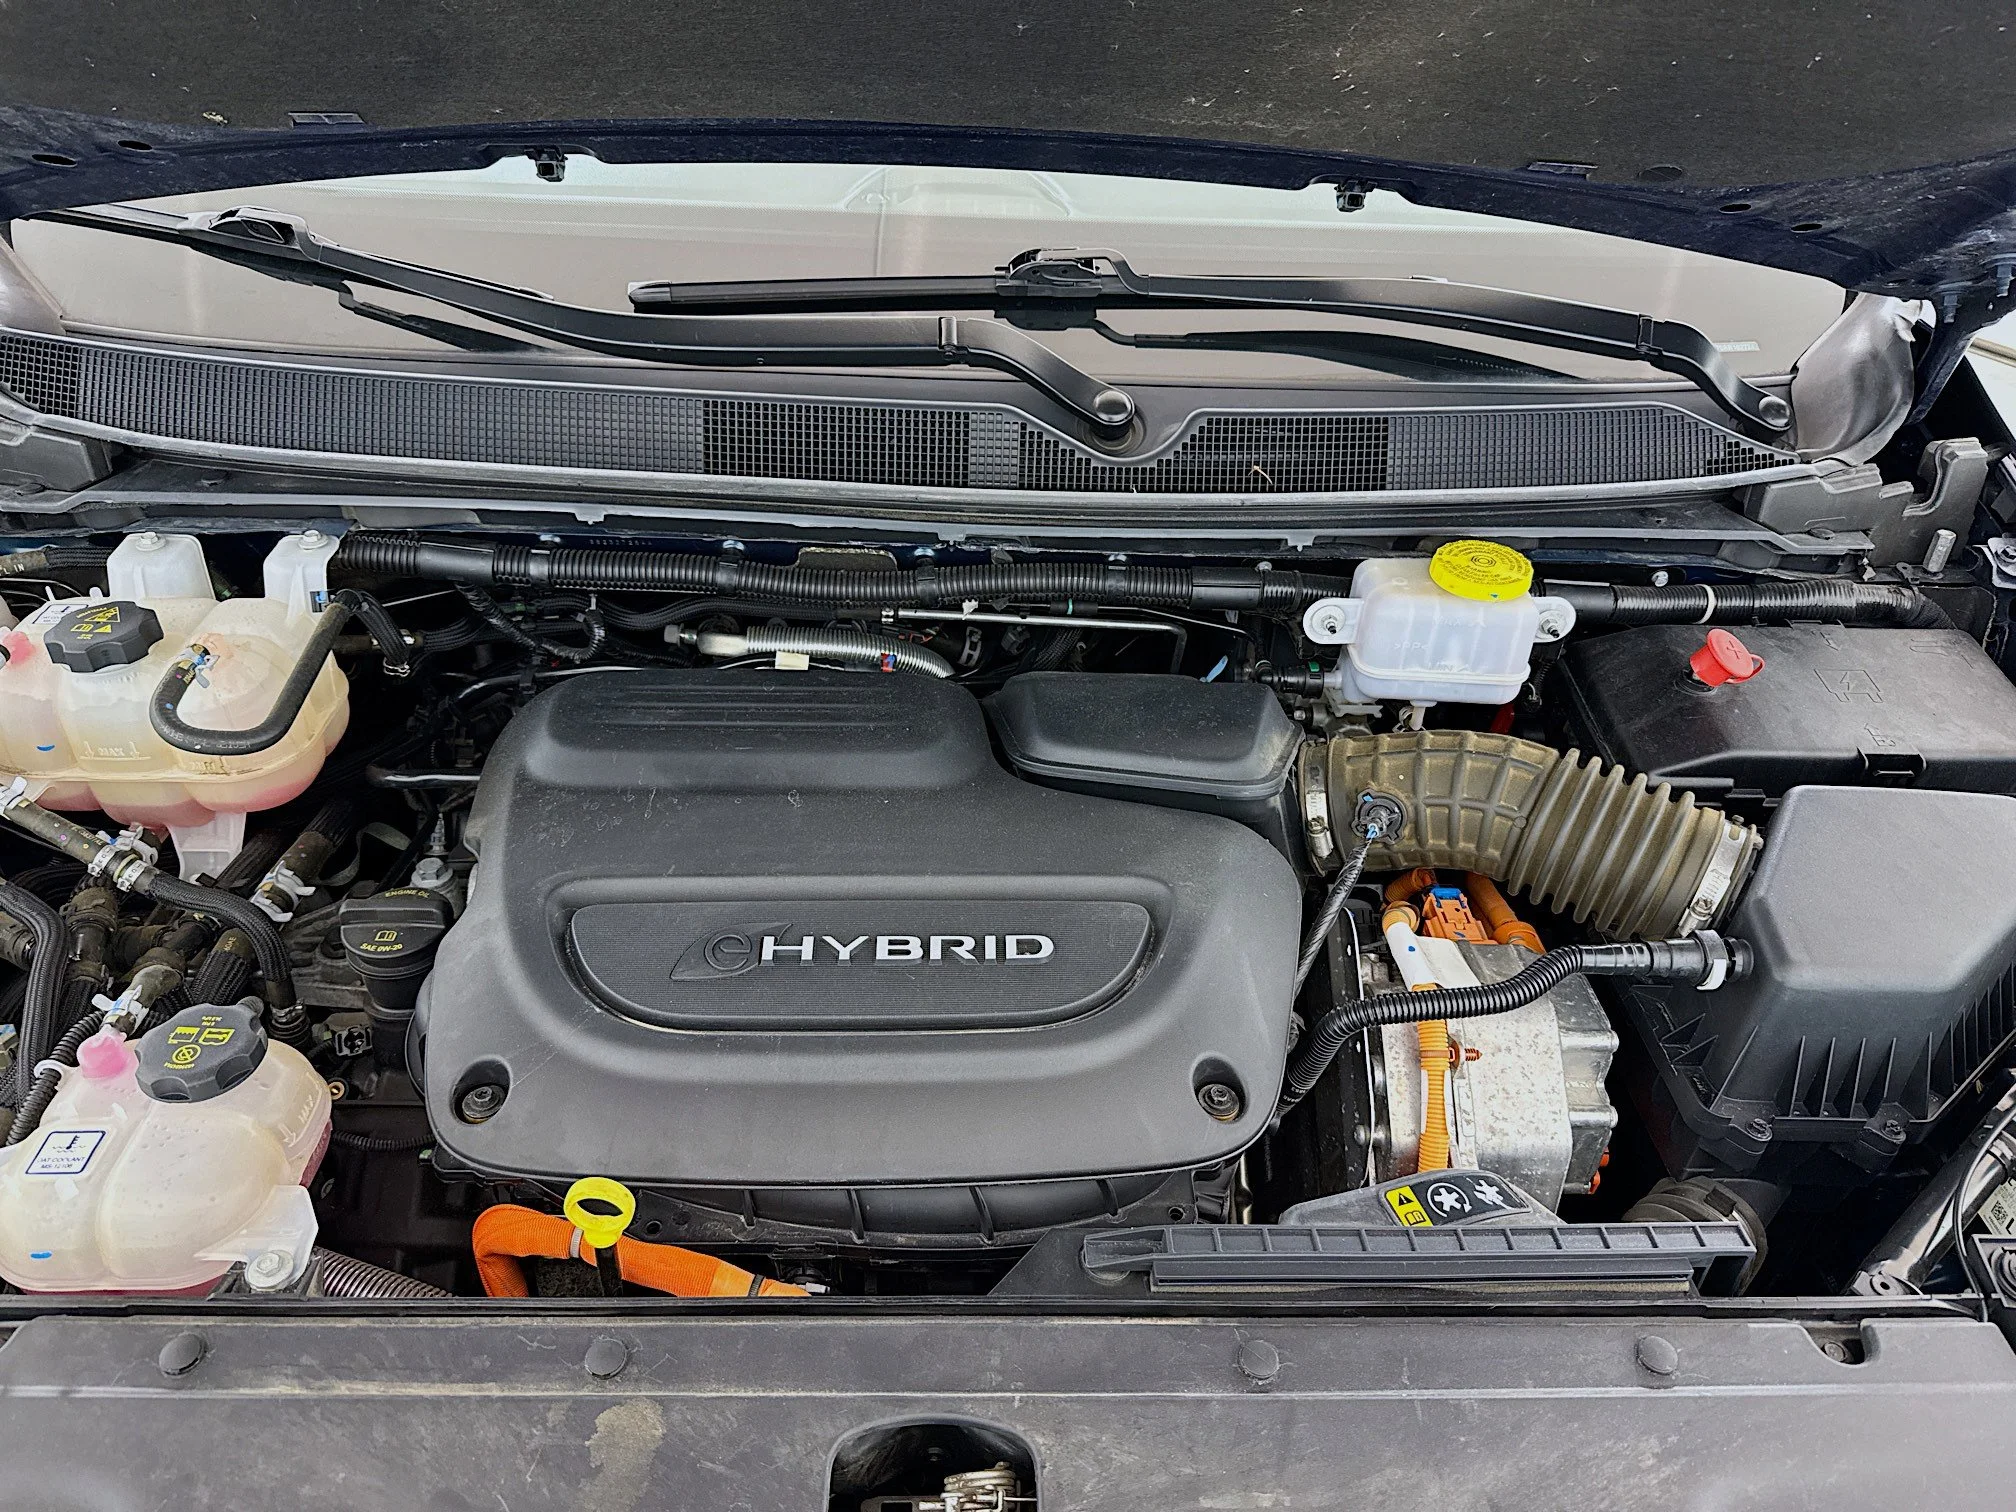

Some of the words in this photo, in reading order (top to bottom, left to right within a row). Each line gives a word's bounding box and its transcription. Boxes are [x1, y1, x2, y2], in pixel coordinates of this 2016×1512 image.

[385, 889, 418, 898] ENGINE
[417, 890, 430, 898] OIL
[360, 942, 377, 951] SAE
[377, 943, 403, 952] 0W-20
